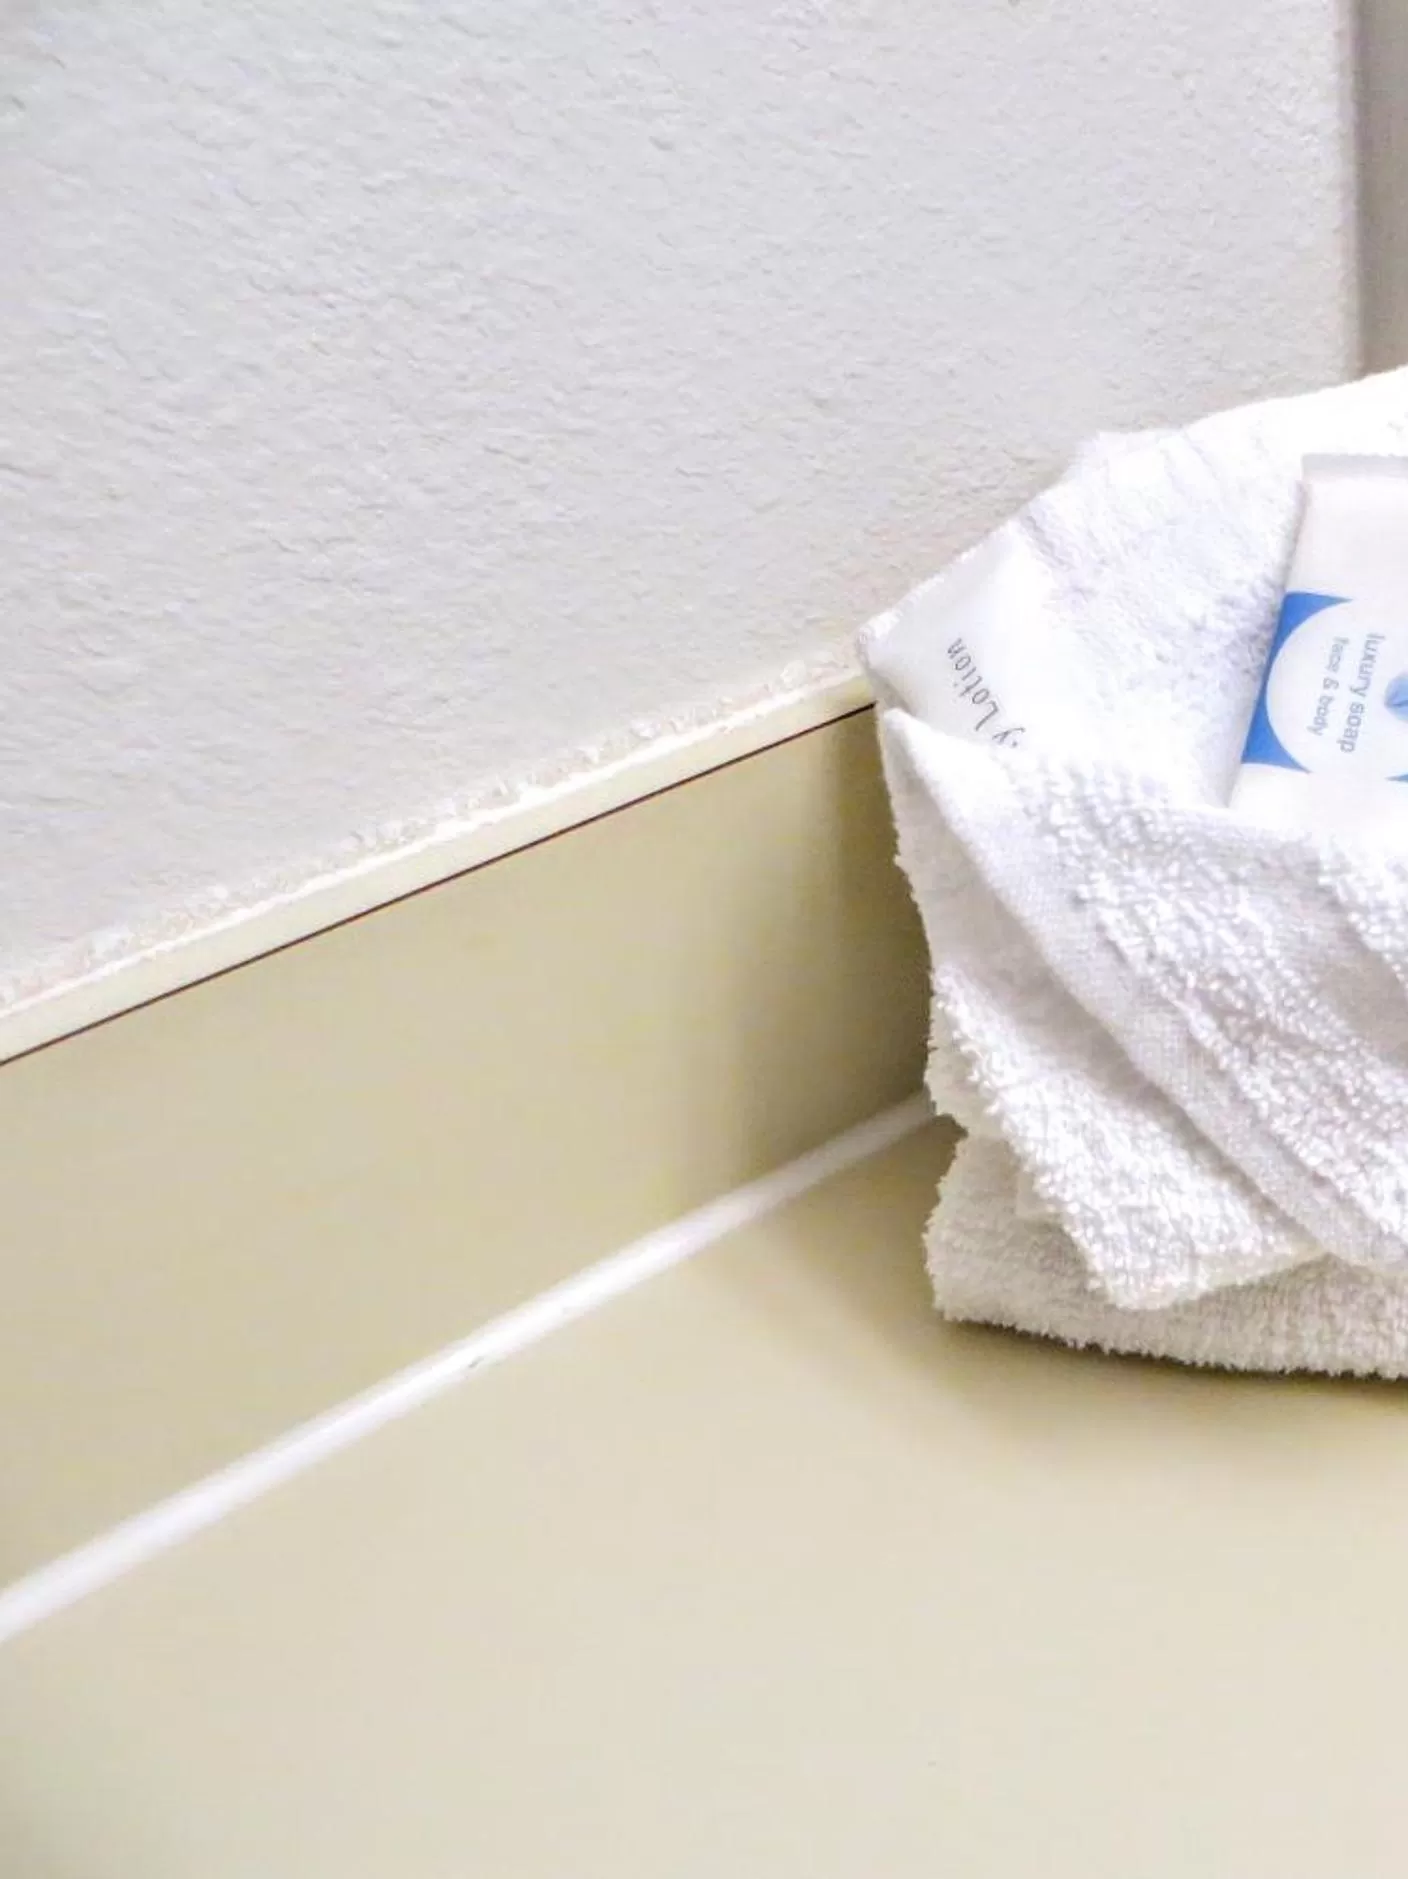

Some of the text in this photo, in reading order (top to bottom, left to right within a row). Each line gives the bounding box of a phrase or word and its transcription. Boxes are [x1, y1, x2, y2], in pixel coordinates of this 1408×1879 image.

[947, 637, 999, 732] Lotion
[1306, 636, 1349, 736] face & body
[1337, 632, 1386, 753] luxury soap
